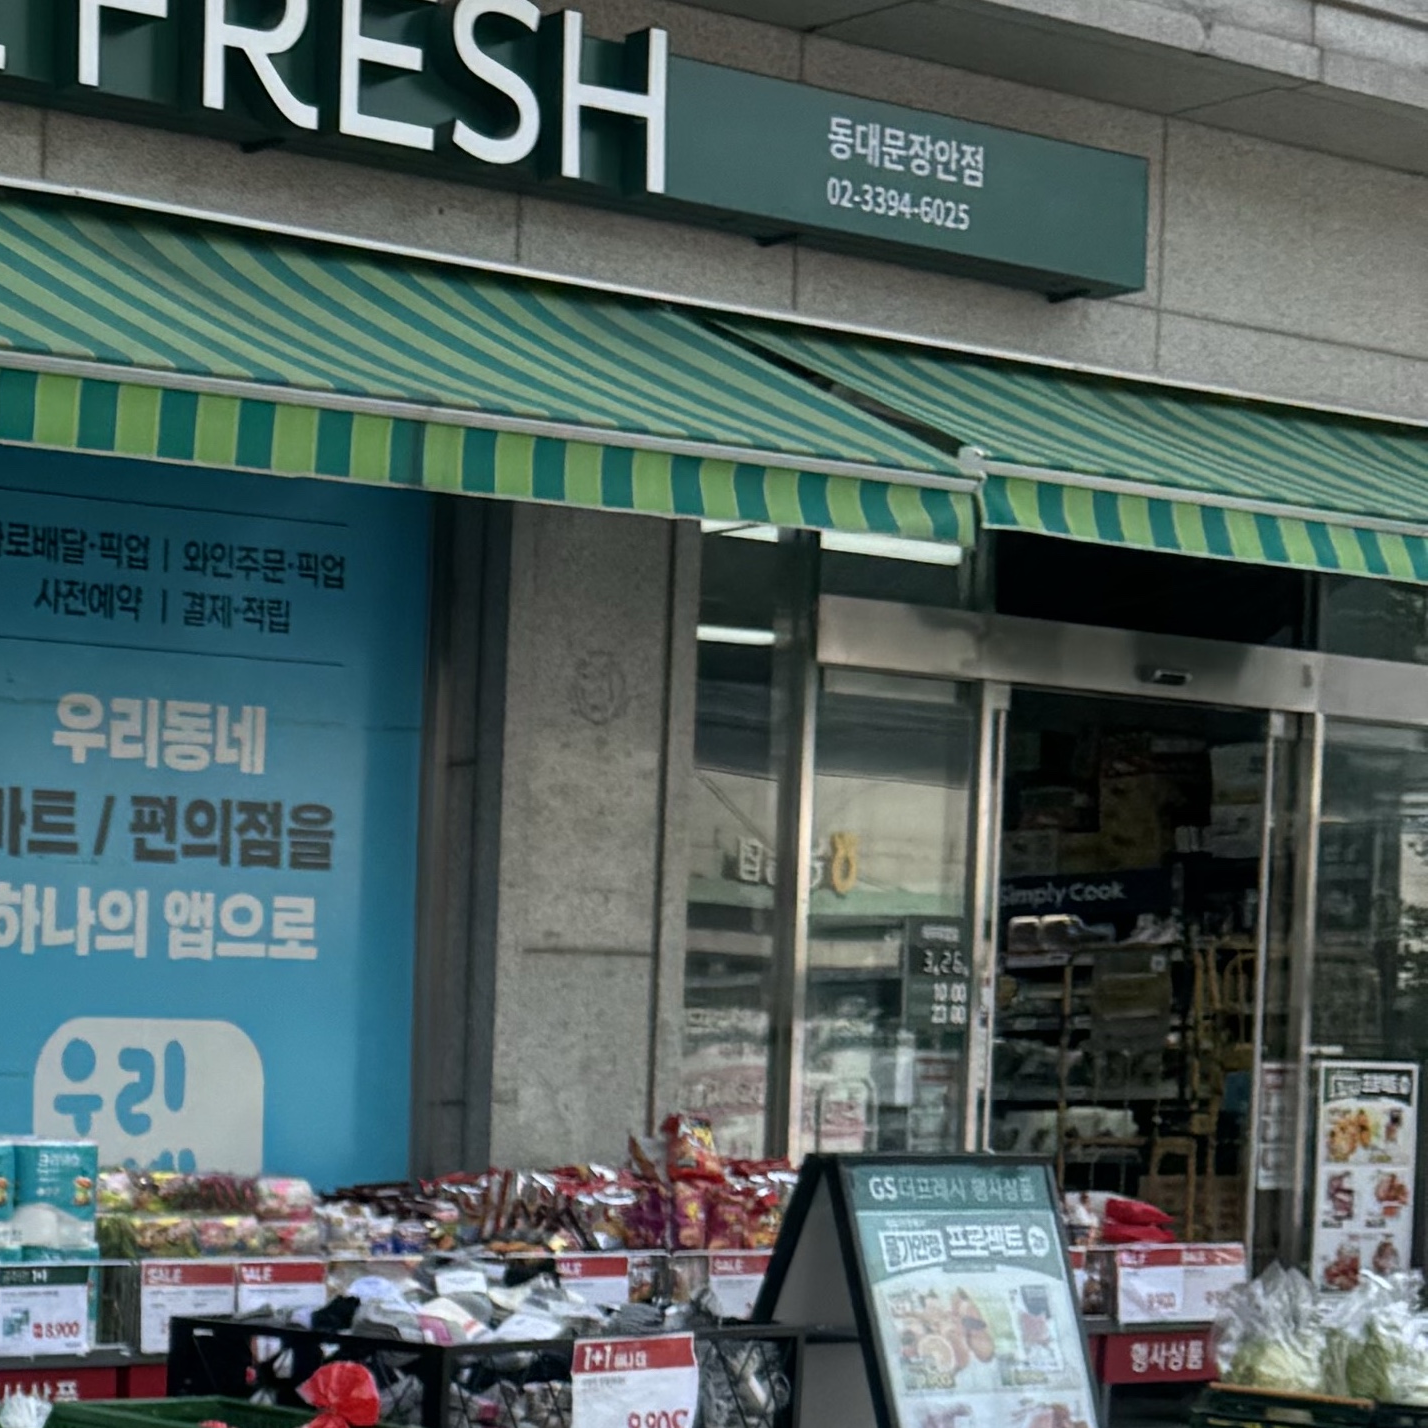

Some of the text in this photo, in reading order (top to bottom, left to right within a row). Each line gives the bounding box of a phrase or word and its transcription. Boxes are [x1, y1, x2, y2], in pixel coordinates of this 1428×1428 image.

[78, 0, 668, 194] FRESH
[828, 116, 985, 188] 동대문장안점
[827, 177, 971, 231] 02-3394-6025
[33, 577, 144, 623] 사전예약
[52, 692, 268, 775] 우리동네
[128, 794, 336, 872] 편의점을
[163, 889, 319, 962] 앱으로
[583, 1344, 612, 1371] 1+1
[1129, 1340, 1205, 1374] 행사상품
